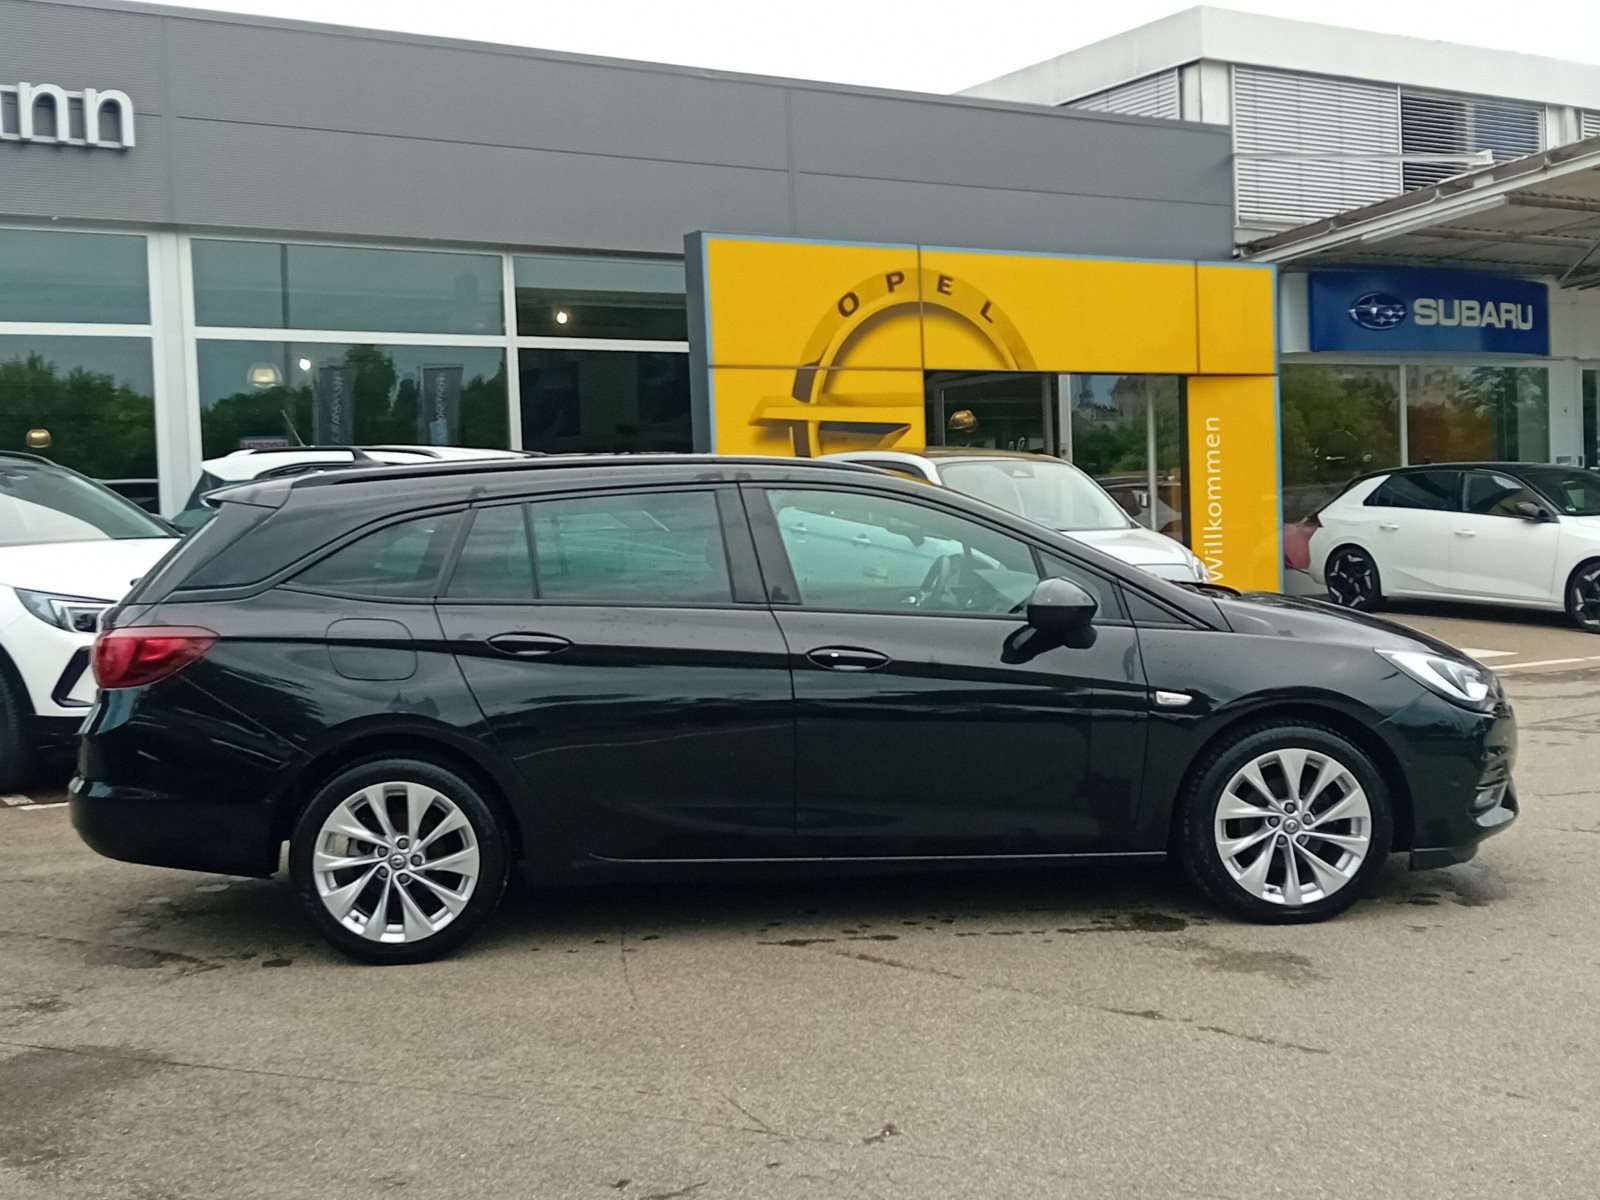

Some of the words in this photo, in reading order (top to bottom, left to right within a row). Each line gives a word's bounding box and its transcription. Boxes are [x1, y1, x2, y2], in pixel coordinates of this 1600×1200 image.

[0, 82, 135, 147] nn
[837, 271, 994, 324] OPEL
[1413, 297, 1533, 330] SUBARU
[1203, 416, 1225, 583] Willkommen
